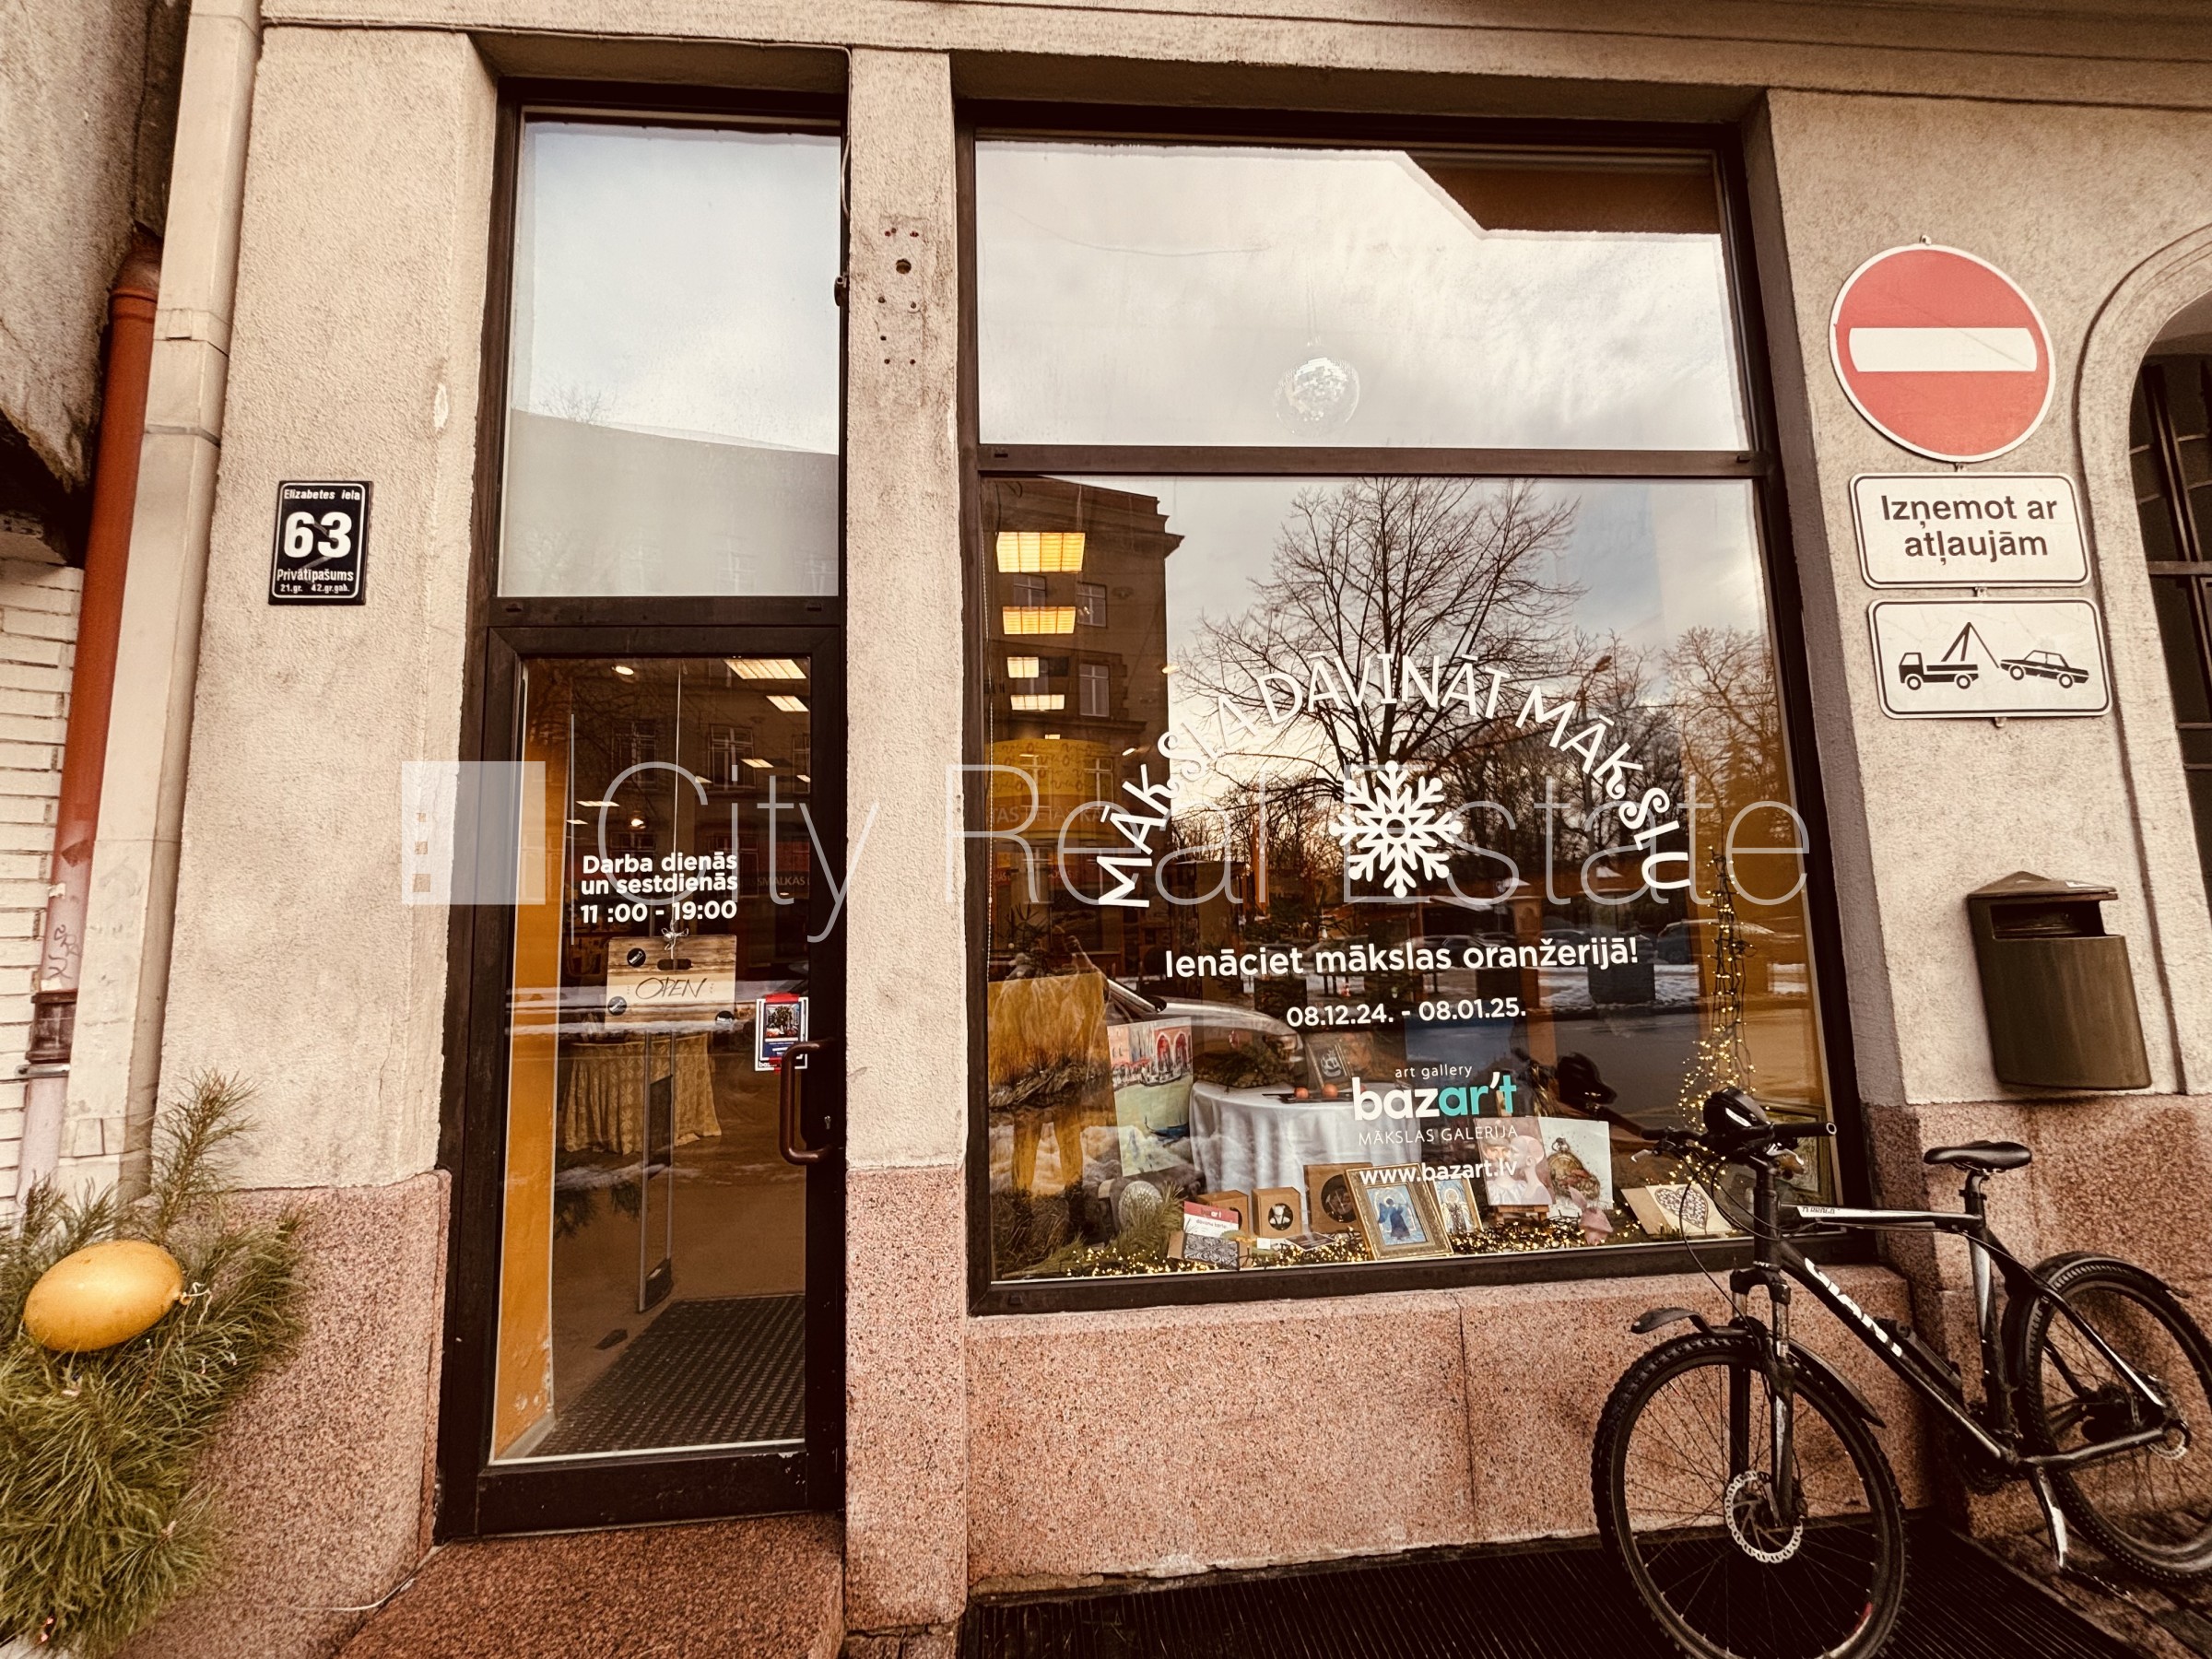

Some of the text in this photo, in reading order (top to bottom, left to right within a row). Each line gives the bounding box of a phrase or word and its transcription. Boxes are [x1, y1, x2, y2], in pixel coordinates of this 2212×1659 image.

[284, 488, 360, 500] Elizabetes iela
[1880, 495, 2058, 528] Izņemot ar
[284, 511, 352, 559] 63
[1904, 530, 2048, 565] atļaujām
[276, 568, 354, 582] Privātīpašums
[1515, 685, 1692, 889] MĀKSLU
[582, 852, 737, 874] Darba dienās
[581, 879, 609, 895] un
[616, 873, 738, 894] sestdienās
[671, 900, 738, 921] 19:00
[1165, 936, 1639, 978] Ienāciet mākslas oranžerijā!
[635, 977, 708, 1000] OPEN
[1286, 1003, 1394, 1028] 08.12.24.
[1418, 996, 1527, 1021] 08.01.25.
[1394, 1064, 1472, 1080] art gallery
[1351, 1071, 1517, 1121] bazar't
[1359, 1124, 1519, 1147] MĀKSLAS GALERIJA
[1359, 1159, 1518, 1186] www.bazart.lv
